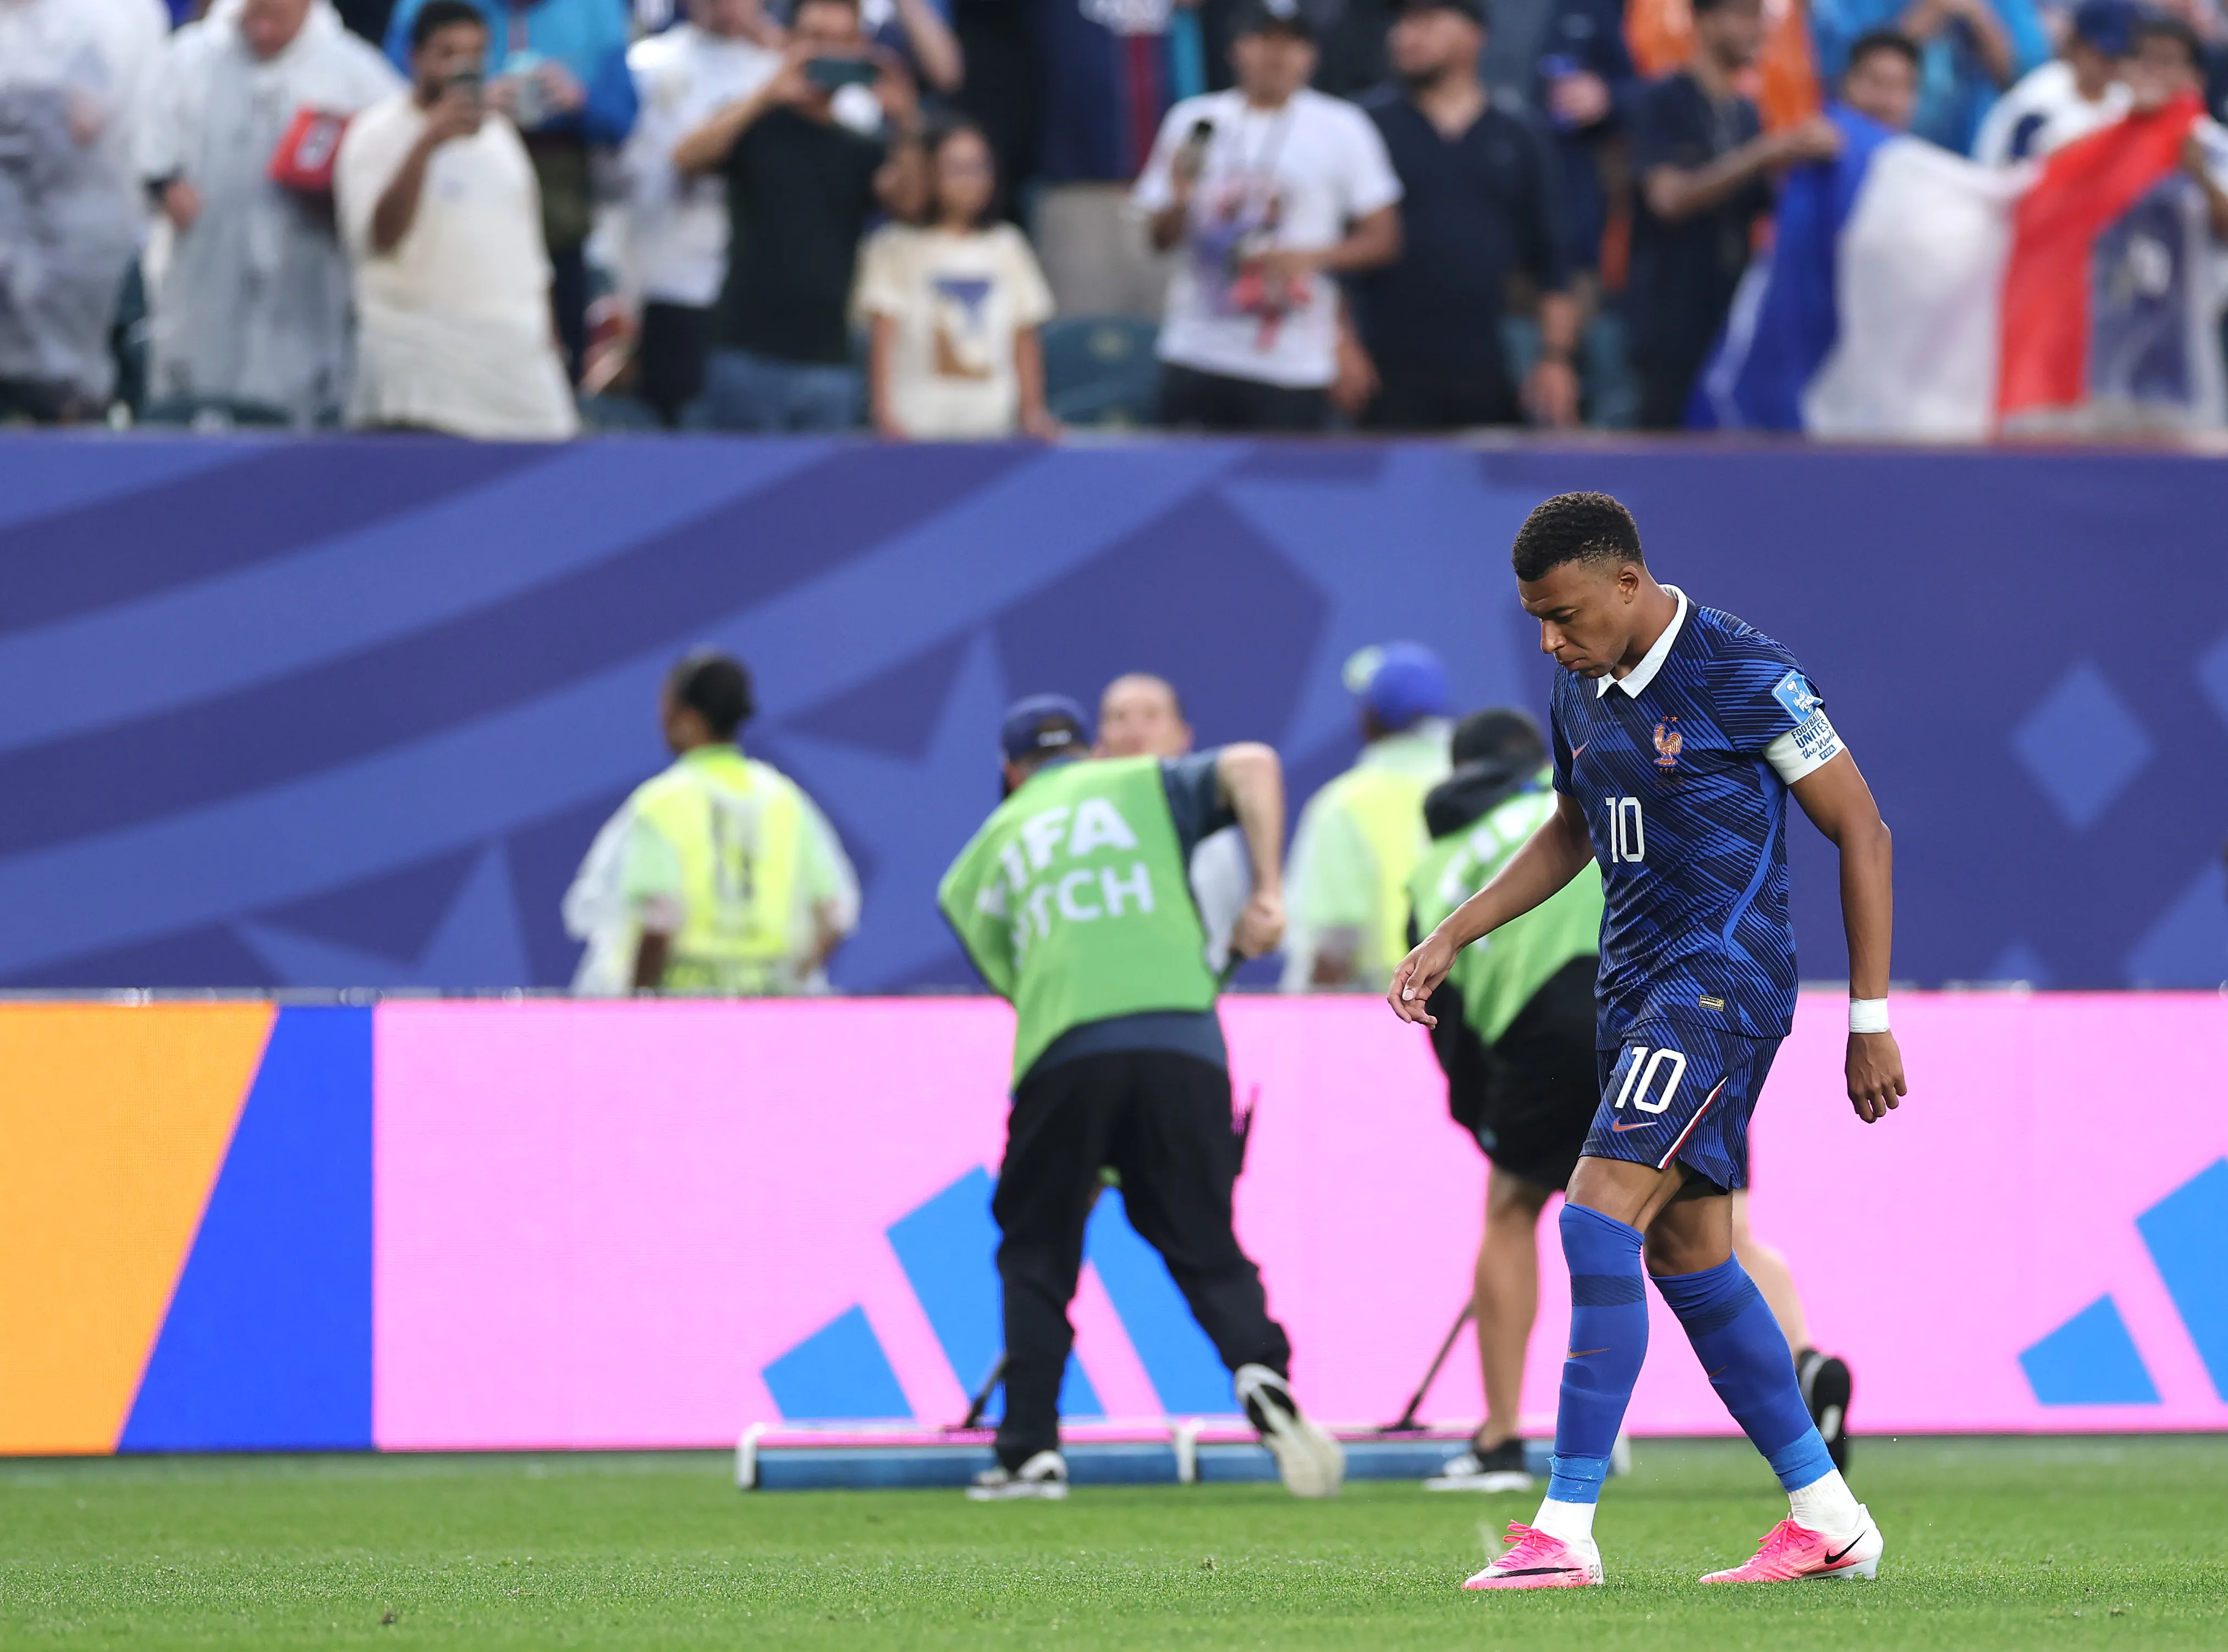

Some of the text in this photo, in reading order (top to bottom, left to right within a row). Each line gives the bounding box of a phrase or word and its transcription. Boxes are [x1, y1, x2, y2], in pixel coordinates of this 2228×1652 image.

[1791, 712, 1822, 739] FOOTBALL
[1795, 719, 1829, 748] UNITES
[1801, 747, 1817, 759] the
[1820, 745, 1835, 759] FIFA
[1605, 797, 1644, 863] 10
[1614, 1047, 1687, 1114] 10
[1588, 1563, 1602, 1579] 58
